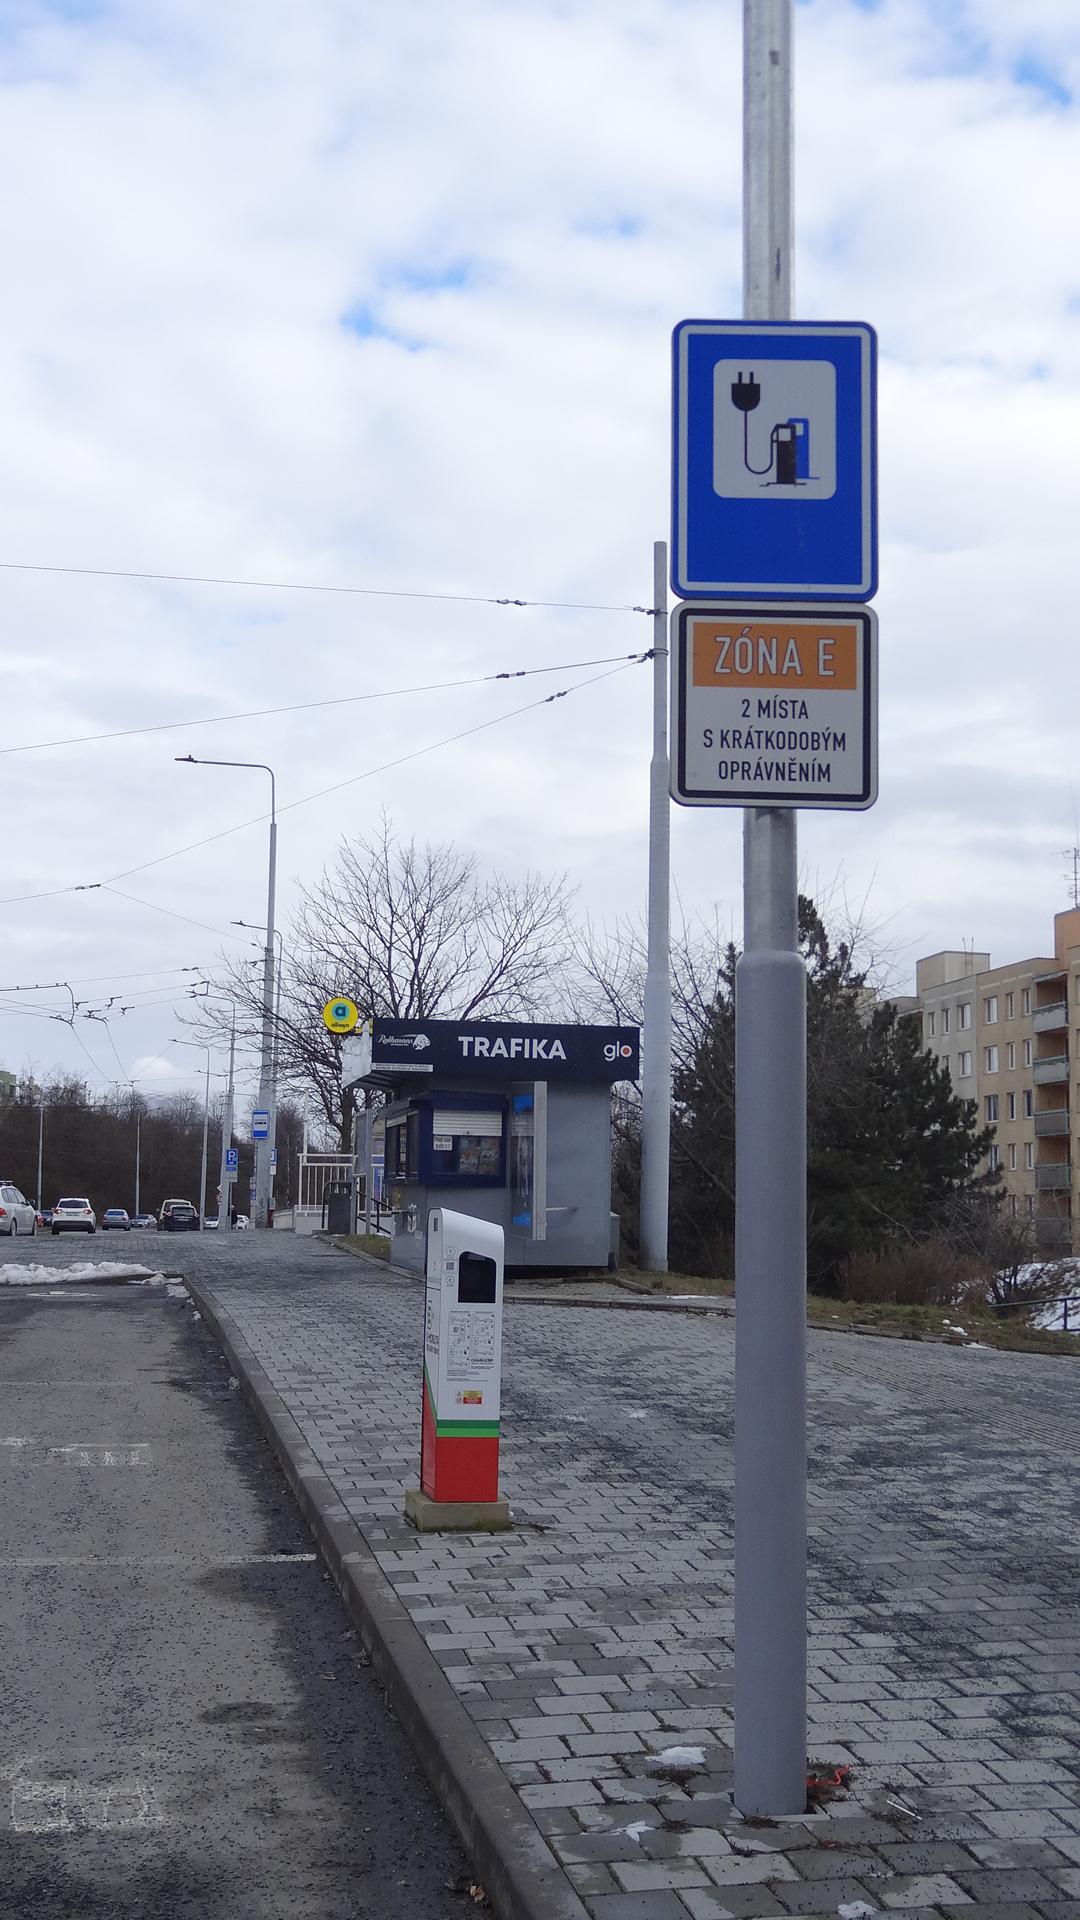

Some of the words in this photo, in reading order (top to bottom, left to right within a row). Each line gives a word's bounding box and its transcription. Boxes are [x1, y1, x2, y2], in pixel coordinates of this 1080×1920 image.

[714, 626, 803, 676] ZÓNA
[817, 637, 836, 677] E
[741, 698, 751, 718] 2
[757, 694, 809, 720] MÍSTA
[703, 729, 713, 748] S
[720, 725, 846, 751] KRÁTKODOBÝM
[718, 756, 831, 782] OPRÁVNĚNÍM
[377, 1034, 414, 1045] Rothmans
[458, 1036, 567, 1060] TRAFIKA
[603, 1041, 633, 1062] glo
[228, 1150, 236, 1161] P
